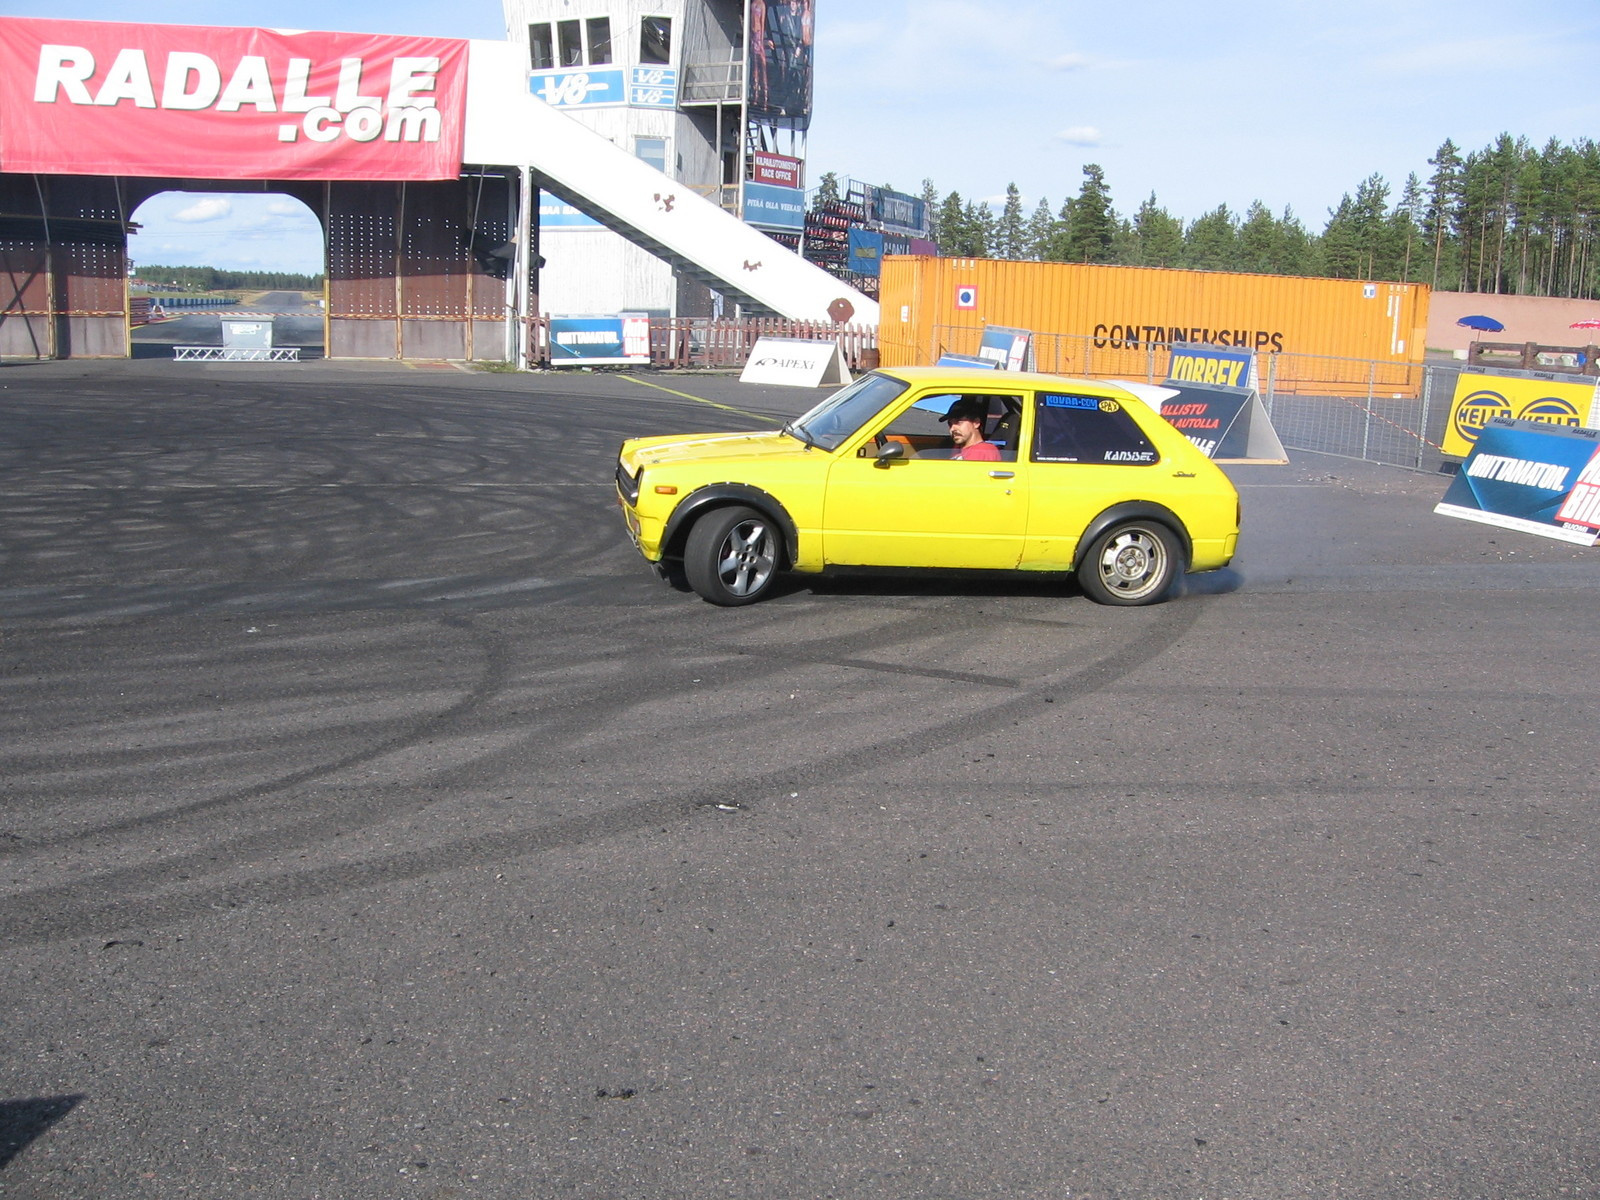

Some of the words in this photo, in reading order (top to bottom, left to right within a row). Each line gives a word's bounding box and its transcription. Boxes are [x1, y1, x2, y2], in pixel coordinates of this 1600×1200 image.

[33, 44, 441, 113] RADALLE
[638, 70, 664, 84] V8
[544, 73, 589, 105] V8
[637, 89, 663, 103] V8
[278, 105, 442, 142] .com
[761, 168, 775, 179] RACE
[775, 170, 792, 181] OFFICE
[1161, 403, 1208, 416] ALLISTU
[1175, 418, 1220, 428] AUTOLLA
[1466, 453, 1571, 492] OHITTAMATON.
[1562, 521, 1589, 533] SUOMI
